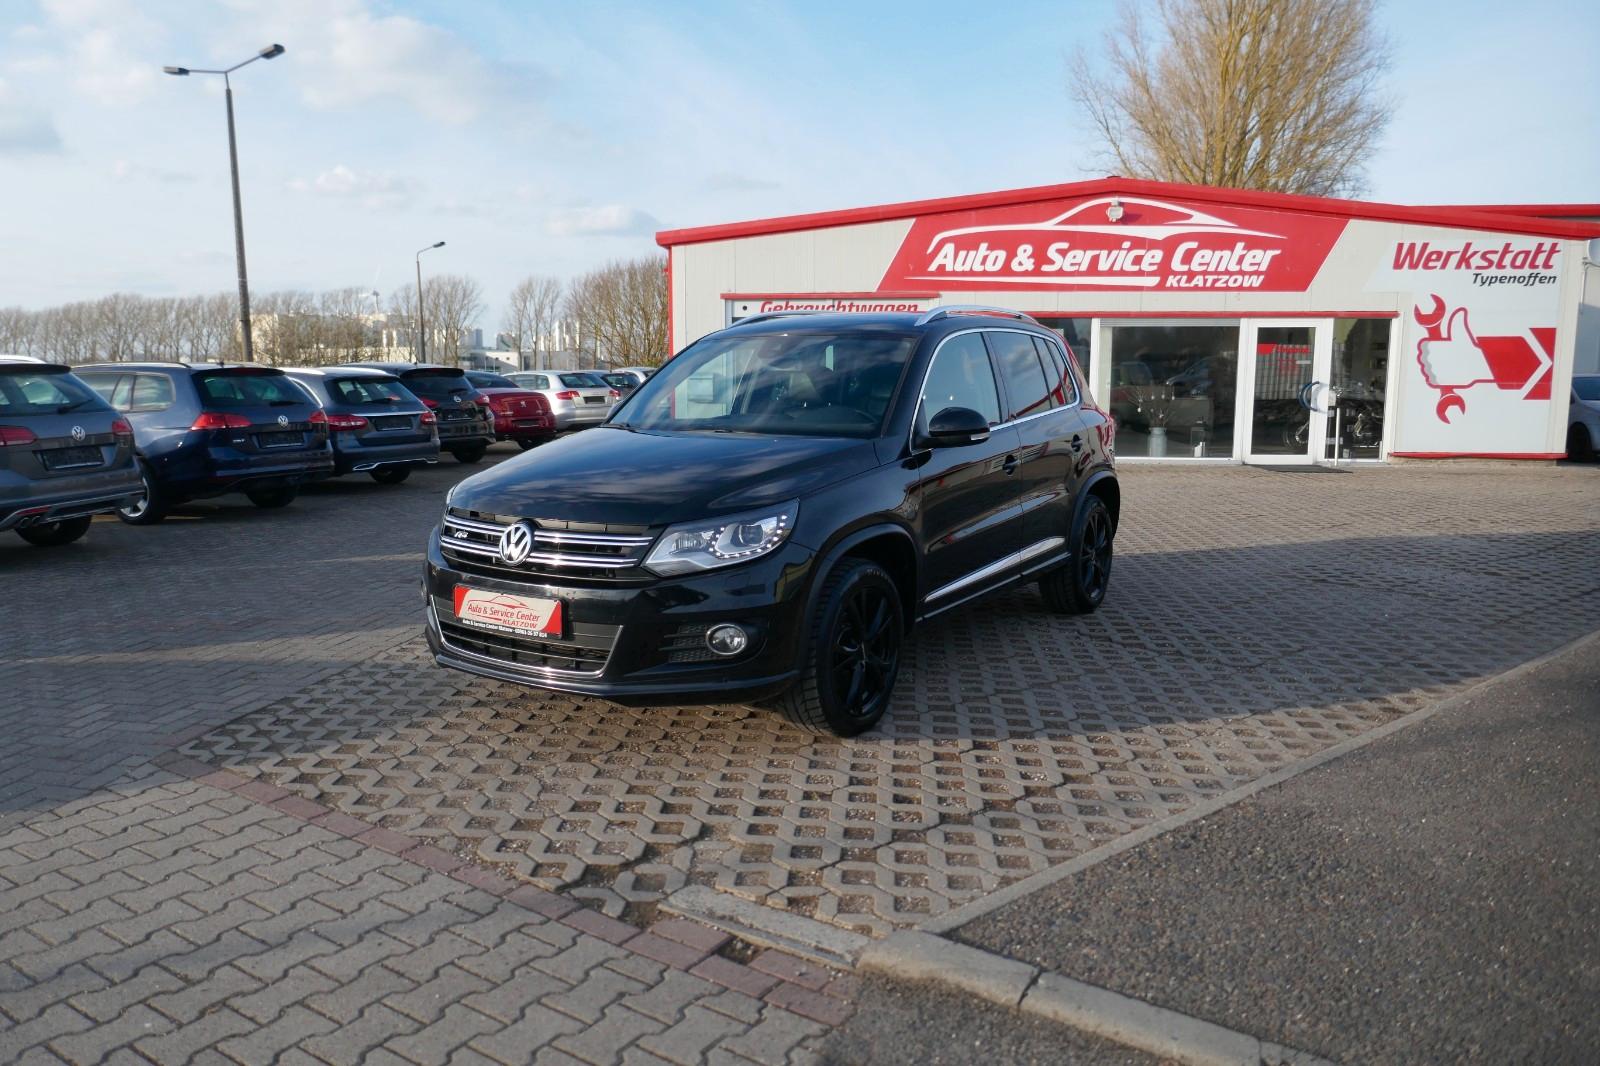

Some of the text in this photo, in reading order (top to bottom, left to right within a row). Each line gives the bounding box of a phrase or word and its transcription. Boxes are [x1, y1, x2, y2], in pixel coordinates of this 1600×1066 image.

[927, 241, 1282, 272] Auto & Service Center
[1392, 242, 1562, 271] Werkstatt
[1165, 275, 1265, 288] KLATZOW
[1472, 272, 1557, 287] Typenoffen
[468, 603, 540, 622] Auto & Service Center
[502, 618, 538, 629] KLATZOW
